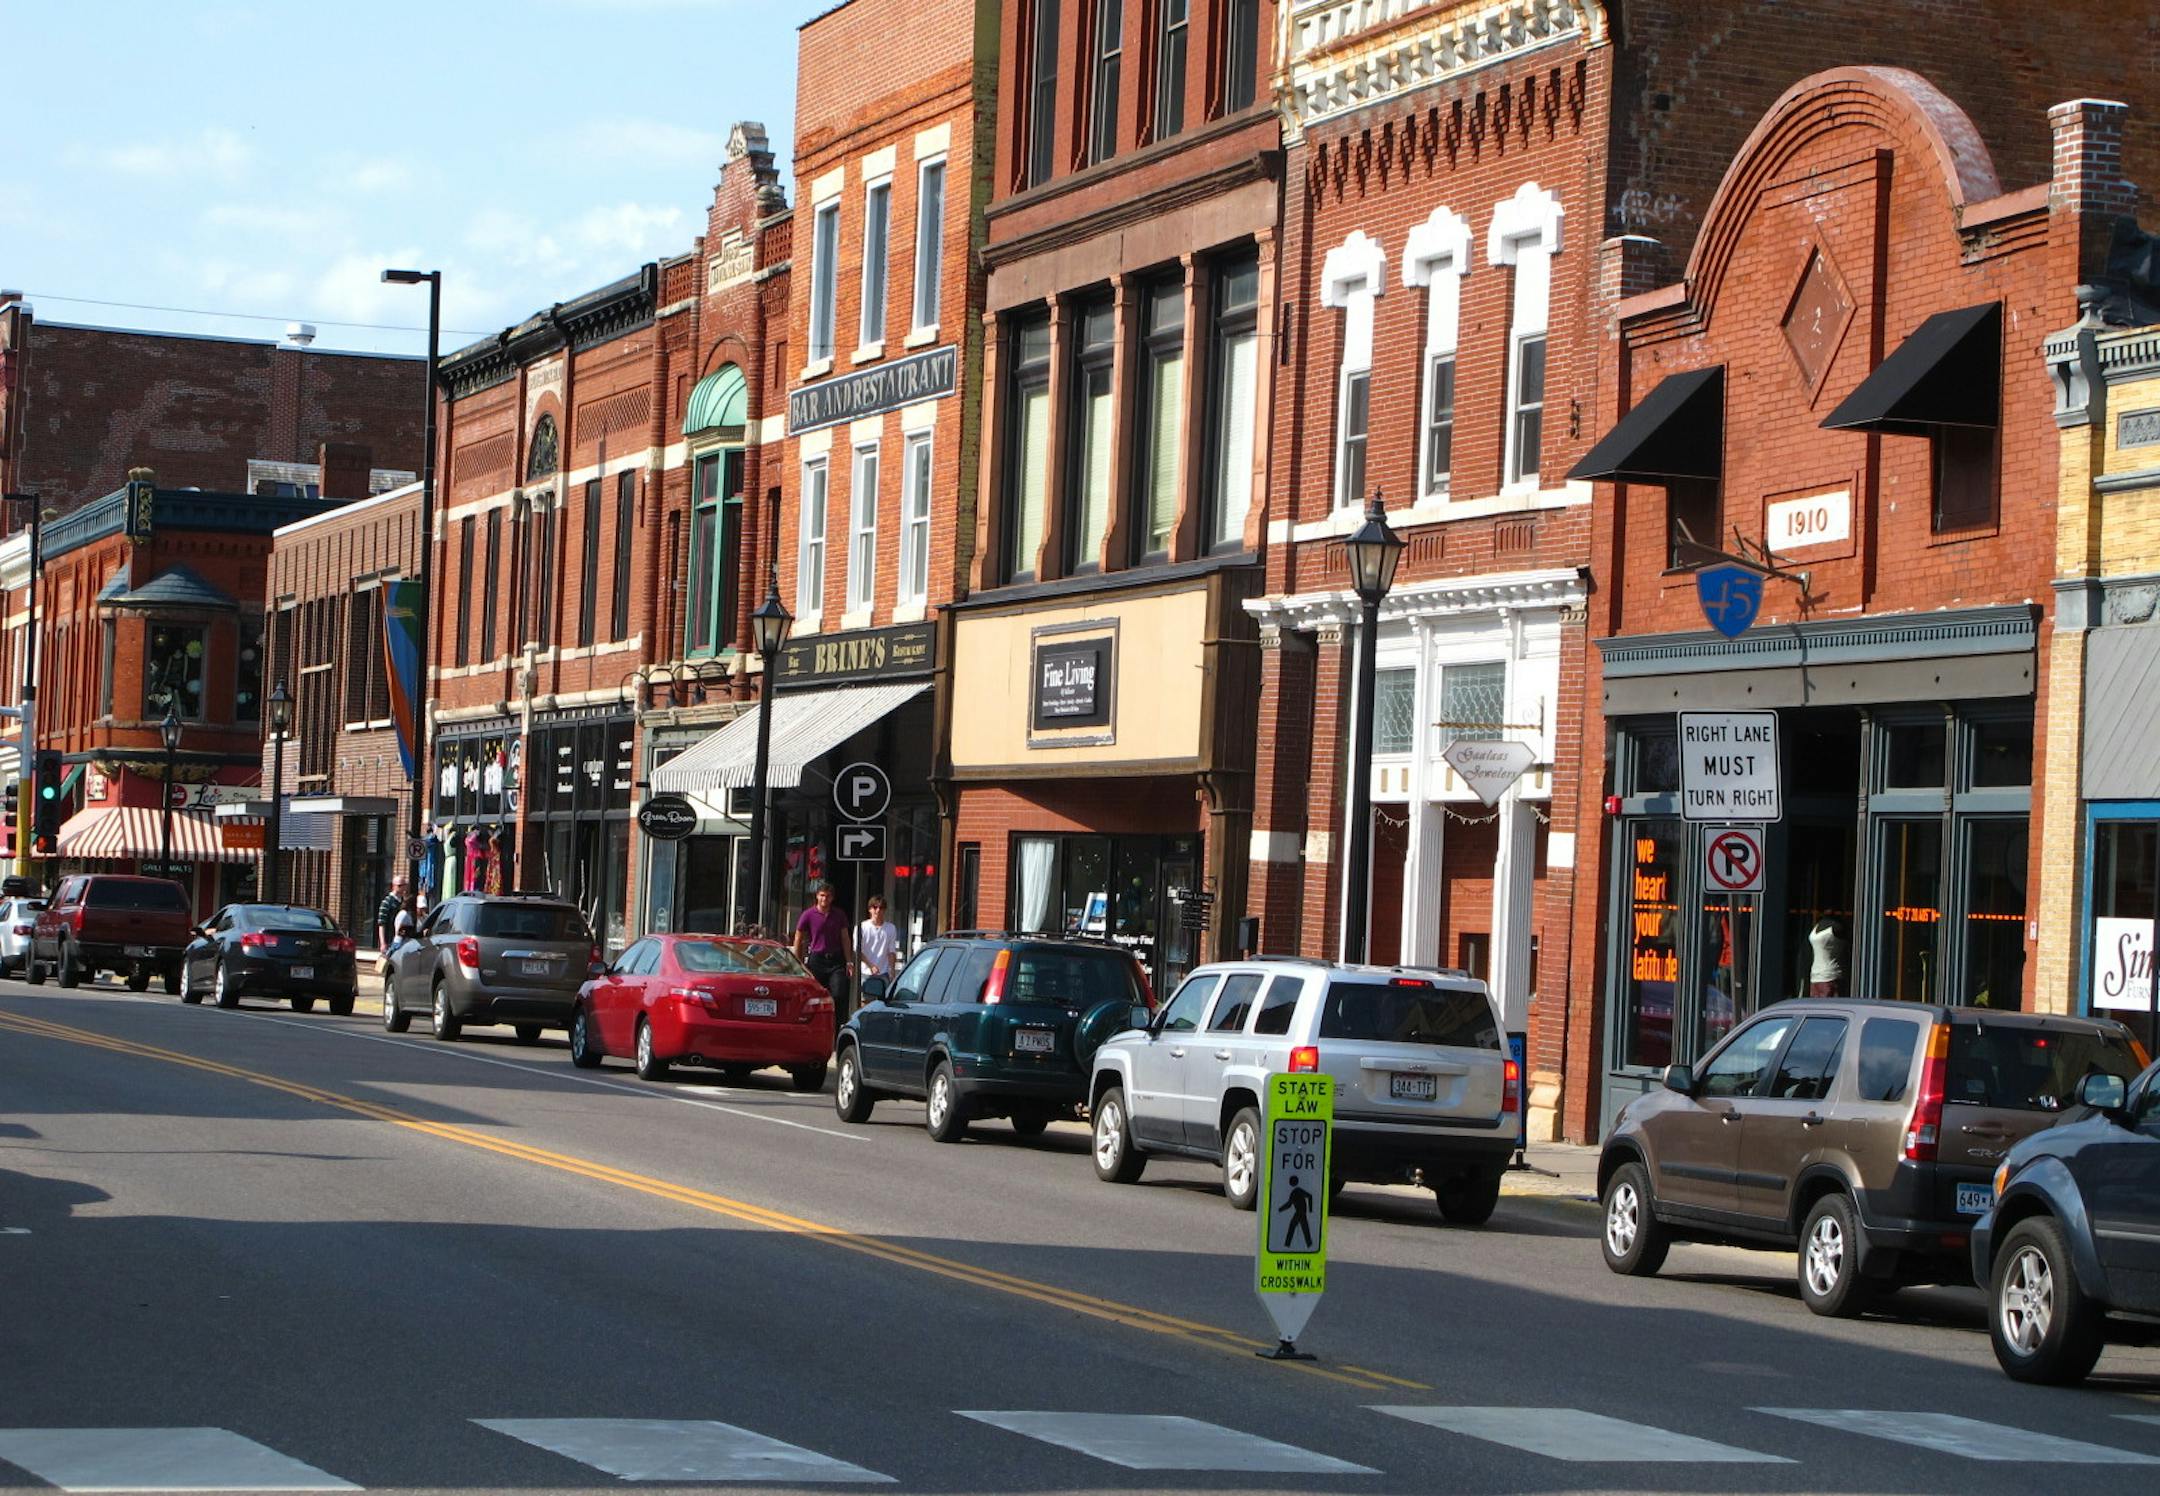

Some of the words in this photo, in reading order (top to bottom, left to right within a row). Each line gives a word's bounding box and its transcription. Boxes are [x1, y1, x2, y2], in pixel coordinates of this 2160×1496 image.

[791, 390, 820, 428] BAR
[823, 384, 850, 417] AND
[852, 353, 953, 411] RESTAURANT
[1788, 507, 1828, 537] 1910
[814, 637, 886, 674] BRINE'S
[1043, 662, 1064, 688] Fine
[1065, 660, 1095, 691] Living
[1686, 726, 1728, 742] RIGHT
[1735, 726, 1771, 742] LANE
[1456, 747, 1509, 764] Gaalaas
[1464, 765, 1517, 780] Jewelers
[1704, 756, 1755, 776] MUST
[852, 776, 878, 808] P
[1688, 790, 1725, 806] TURN
[1733, 790, 1774, 806] RIGHT
[668, 811, 696, 823] Room
[1636, 839, 1655, 864] we
[1634, 867, 1667, 901] heart
[1634, 911, 1662, 945] your
[1632, 947, 1678, 982] latitude
[1278, 1081, 1327, 1096] STATE
[1395, 1080, 1432, 1094] 344-TTF
[1284, 1100, 1318, 1113] LAW
[1278, 1127, 1322, 1145] STOP
[1282, 1153, 1316, 1170] FOR
[1276, 1258, 1312, 1271] WITHIN
[1261, 1275, 1322, 1289] CROSSWALK
